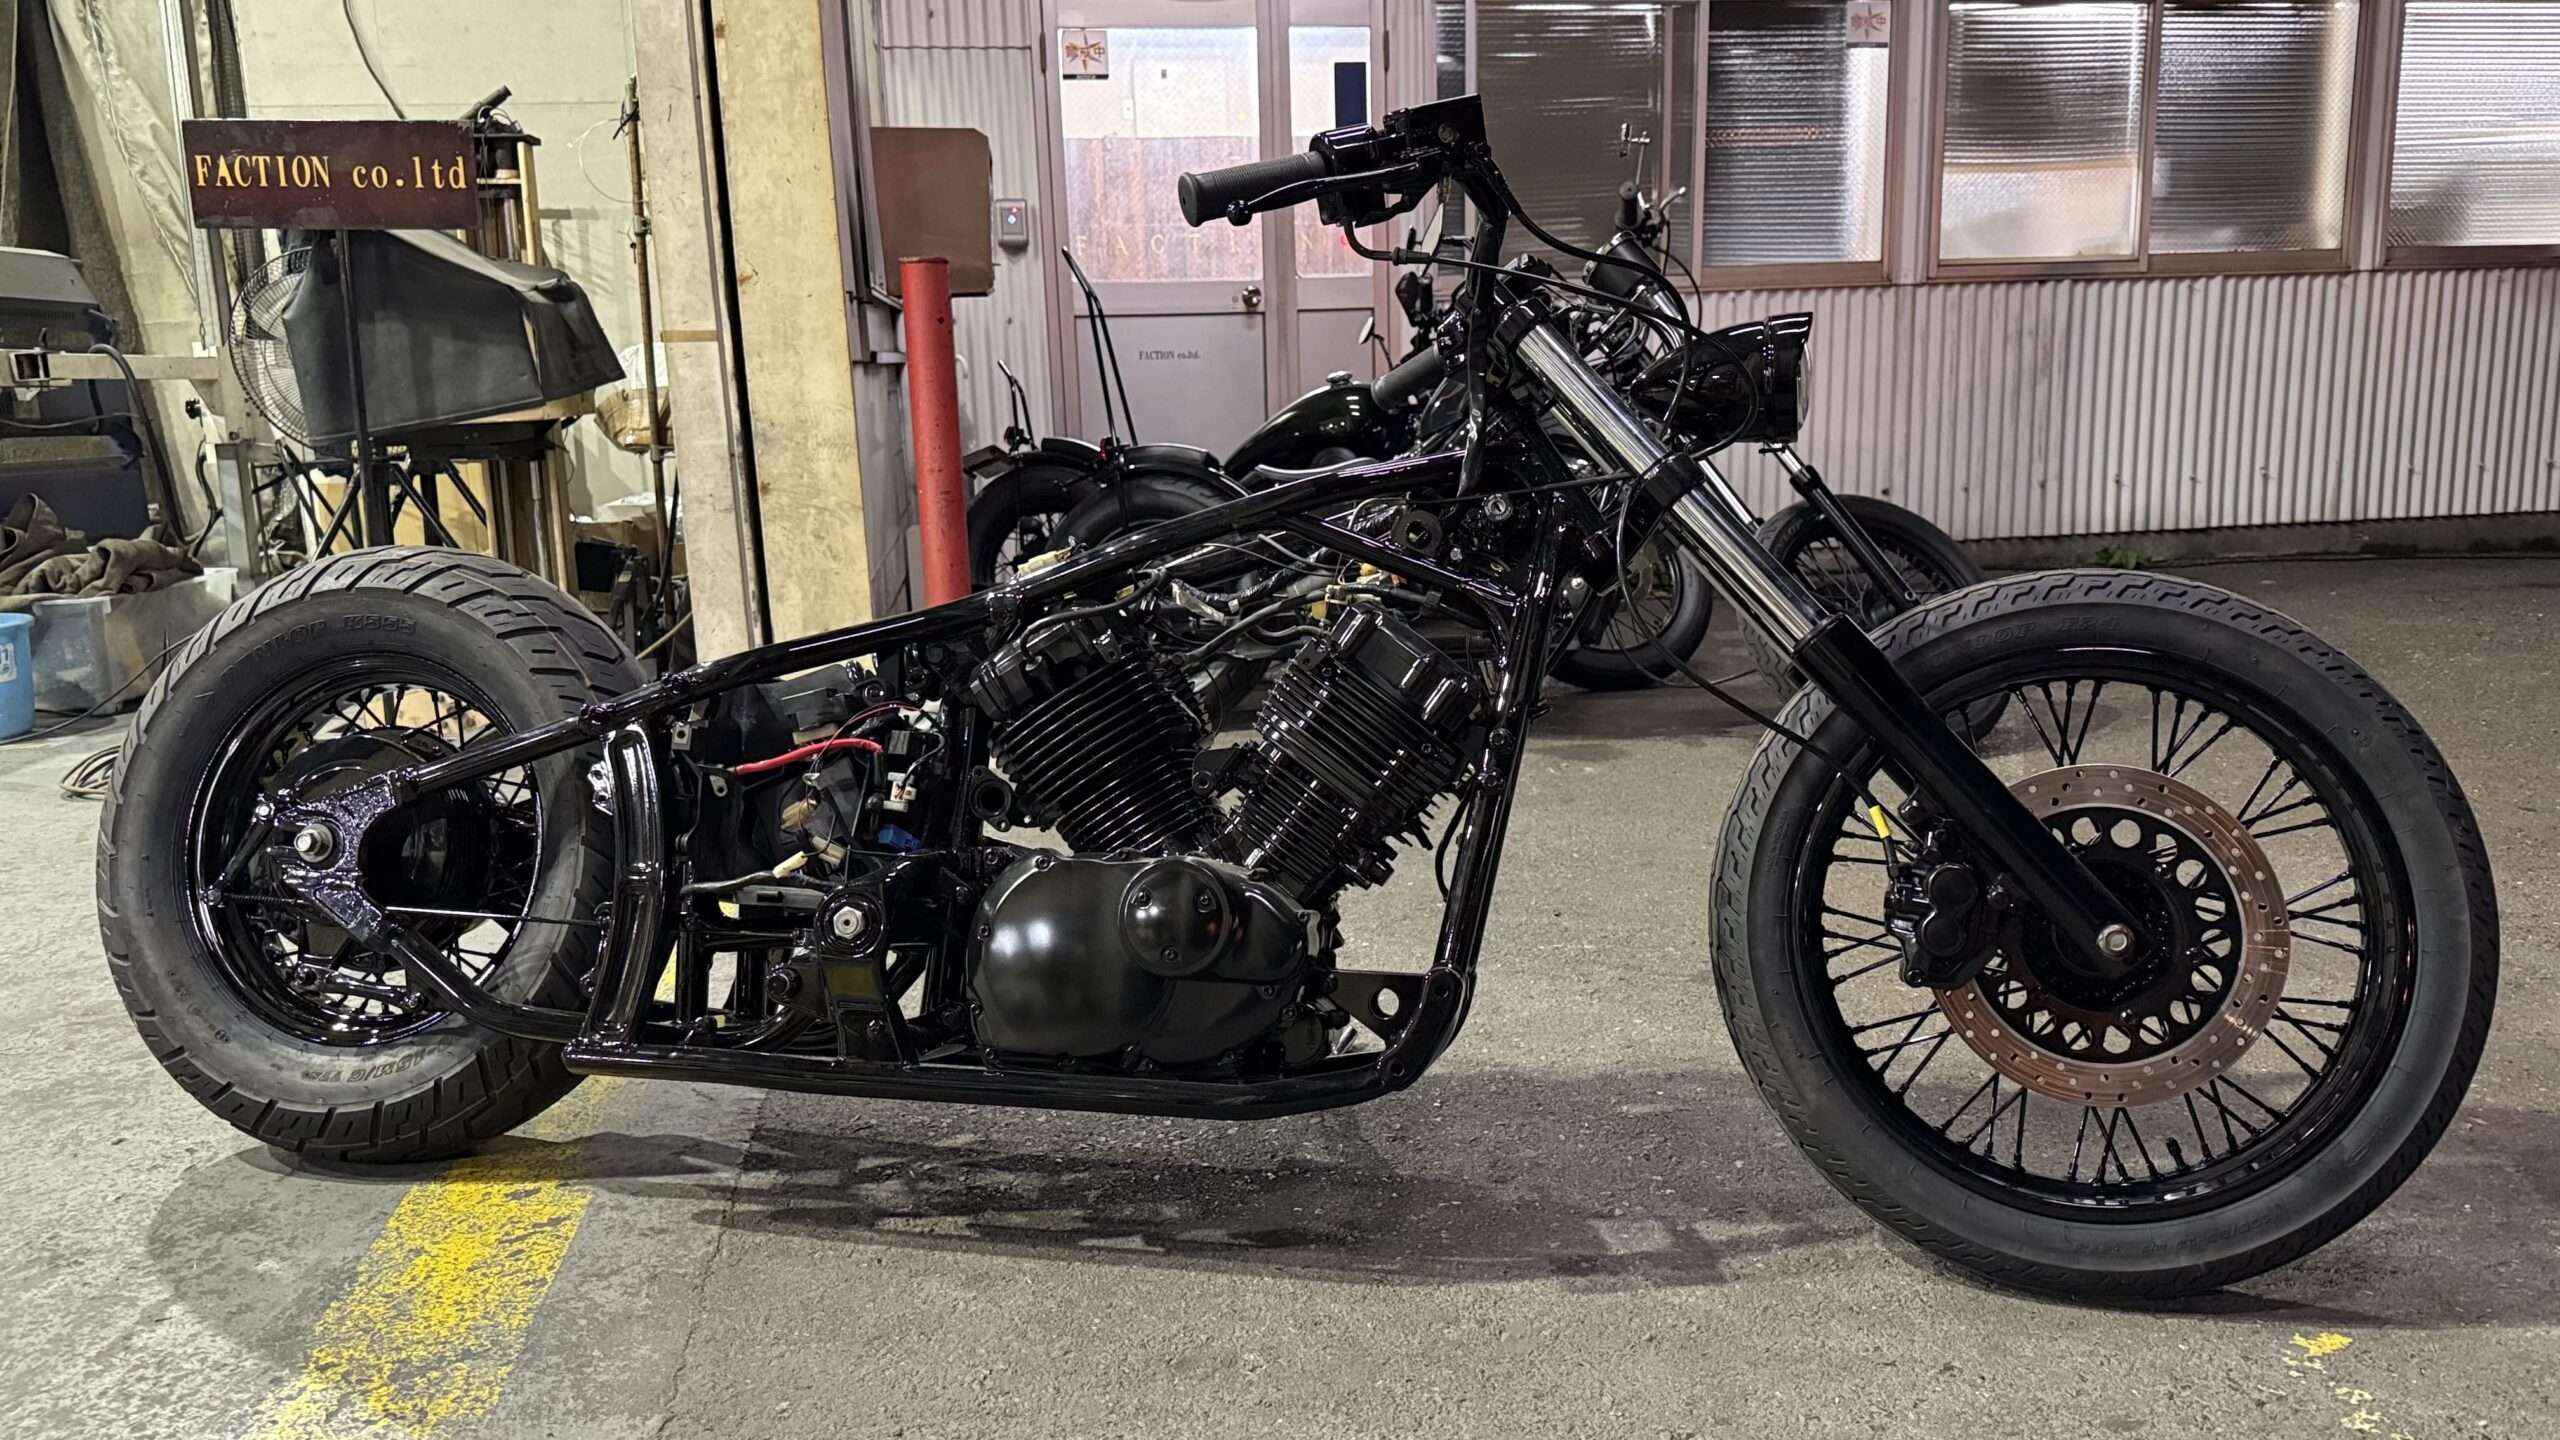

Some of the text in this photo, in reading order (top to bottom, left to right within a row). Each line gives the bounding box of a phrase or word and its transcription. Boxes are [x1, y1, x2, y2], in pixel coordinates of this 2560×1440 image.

[194, 154, 468, 190] FACTION co.ltd
[1138, 350, 1176, 361] FACTION
[342, 613, 417, 635] K555
